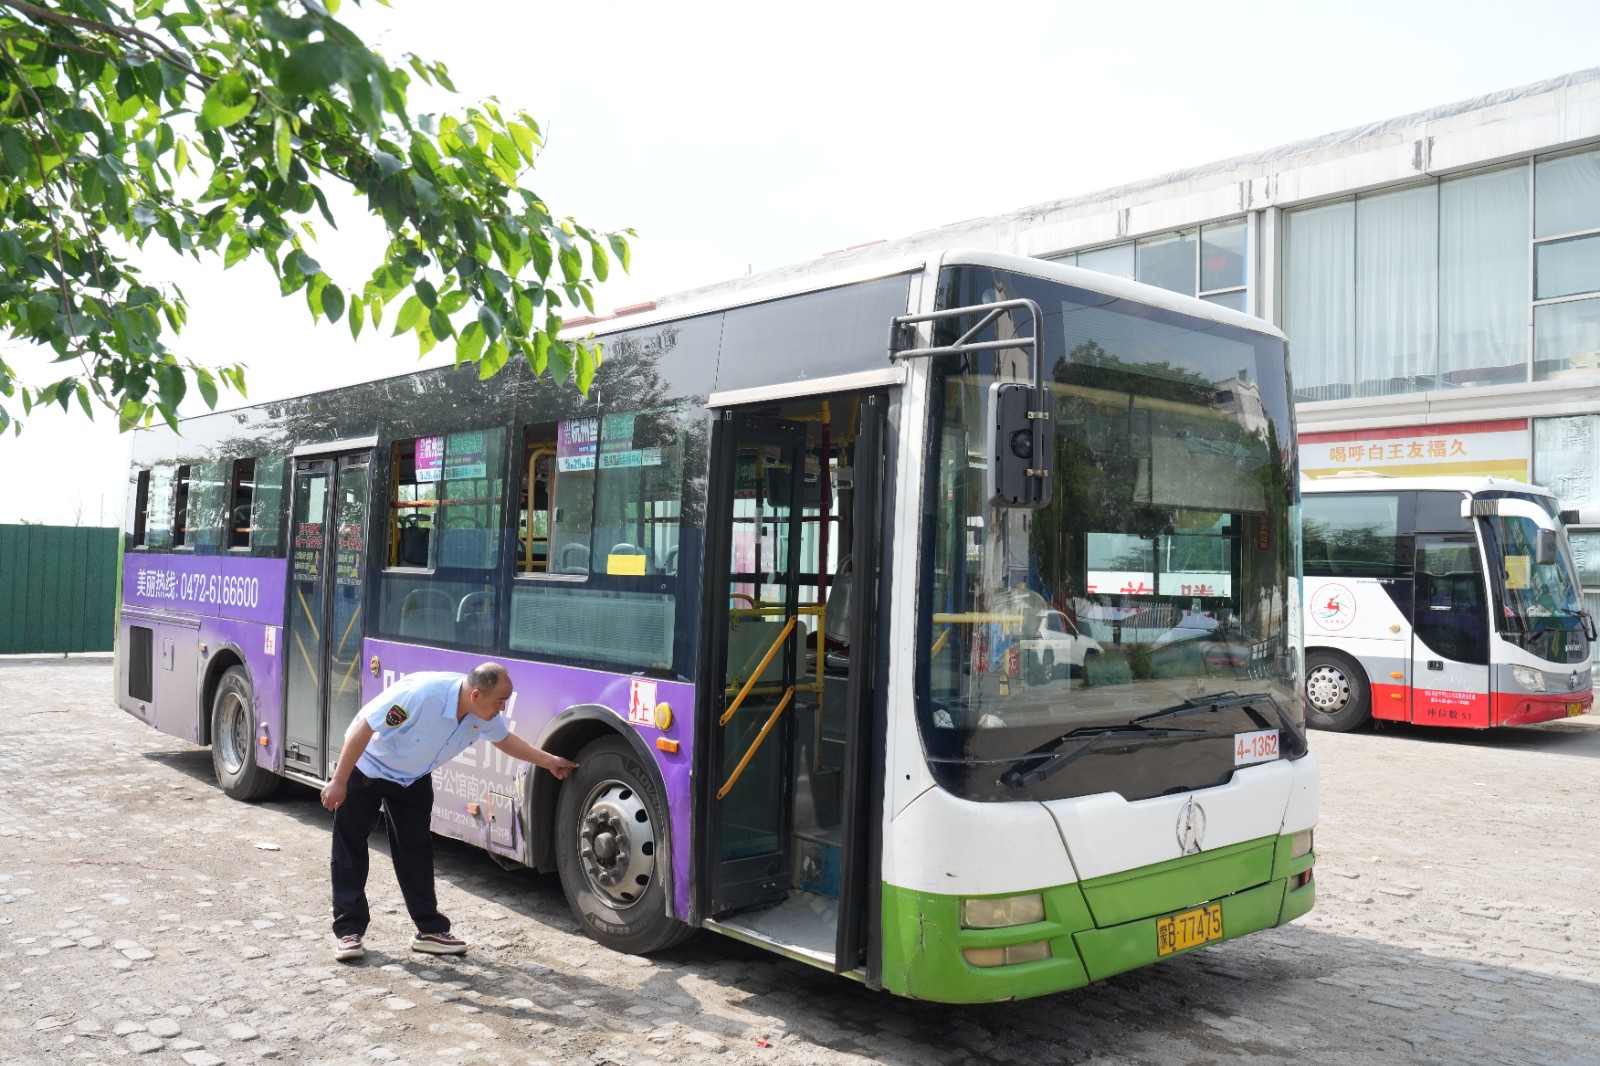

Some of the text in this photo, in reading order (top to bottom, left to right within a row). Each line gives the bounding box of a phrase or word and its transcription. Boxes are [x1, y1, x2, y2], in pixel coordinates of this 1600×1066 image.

[1329, 438, 1468, 462] 喝呼白王友福久
[639, 703, 650, 722] 上
[1237, 734, 1278, 760] 4-1362
